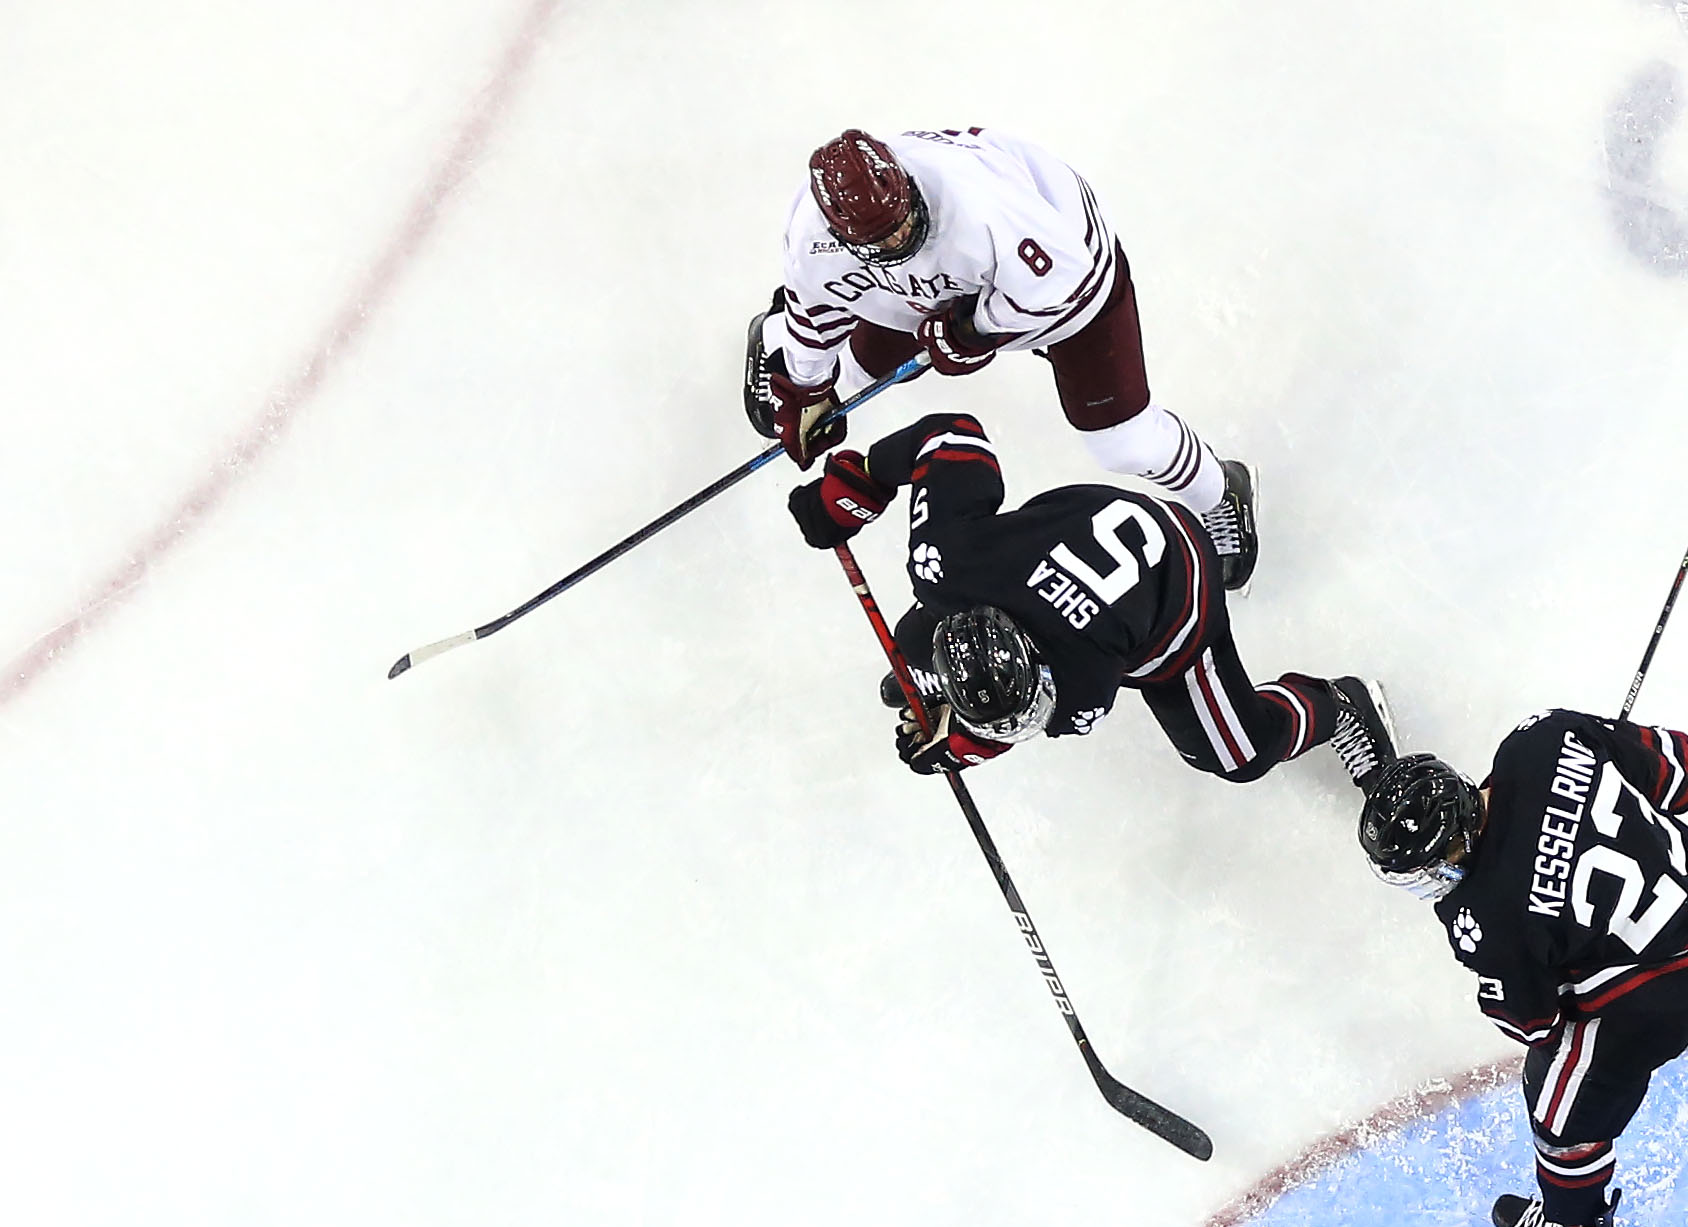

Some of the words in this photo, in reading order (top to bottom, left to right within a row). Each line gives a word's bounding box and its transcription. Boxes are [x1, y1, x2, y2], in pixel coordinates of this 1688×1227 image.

[811, 240, 844, 249] ECA
[1017, 237, 1053, 277] 8
[823, 265, 964, 302] COLGATE
[1050, 498, 1167, 606] 5
[1026, 559, 1100, 630] SHEA
[1011, 911, 1076, 1016] BAUER
